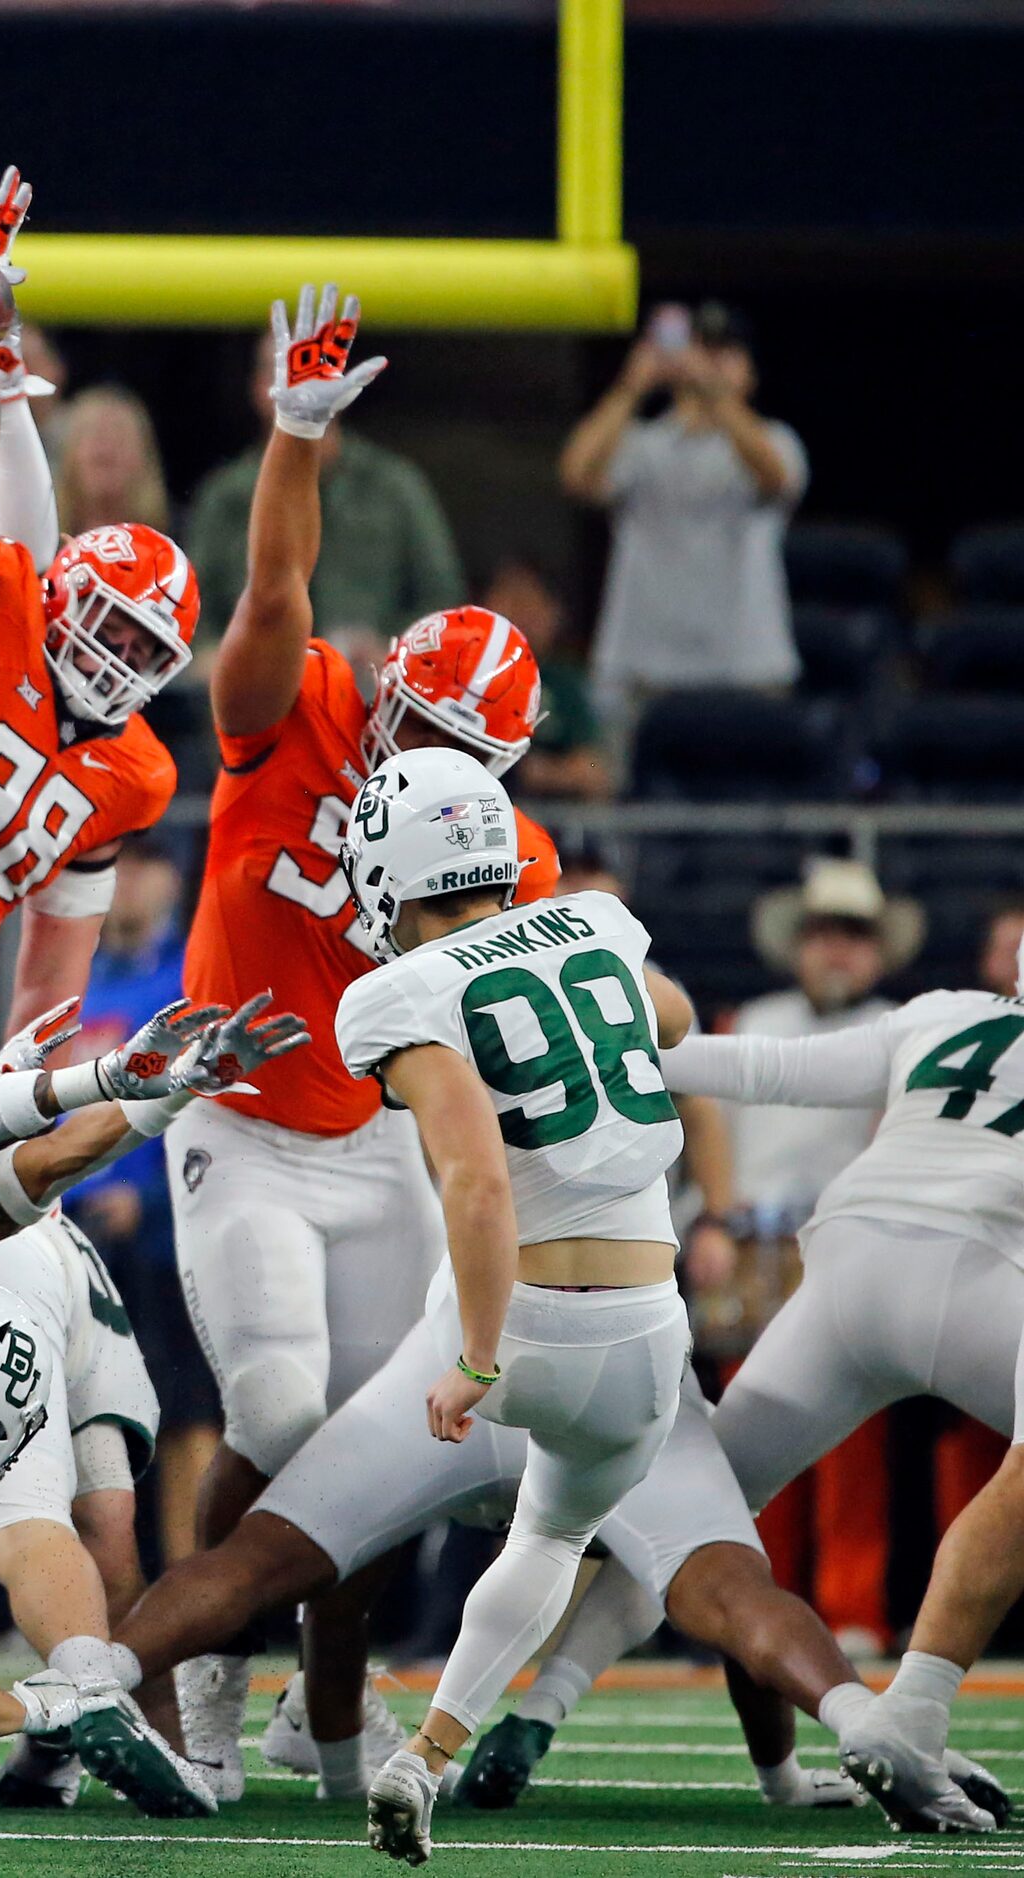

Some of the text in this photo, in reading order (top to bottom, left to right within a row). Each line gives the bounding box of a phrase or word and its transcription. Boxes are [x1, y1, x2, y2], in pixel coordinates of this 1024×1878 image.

[481, 814, 500, 824] UNITY
[442, 863, 512, 890] Riddell
[443, 907, 595, 970] HANKINS
[462, 949, 680, 1150] 98
[0, 1329, 41, 1408] BU
